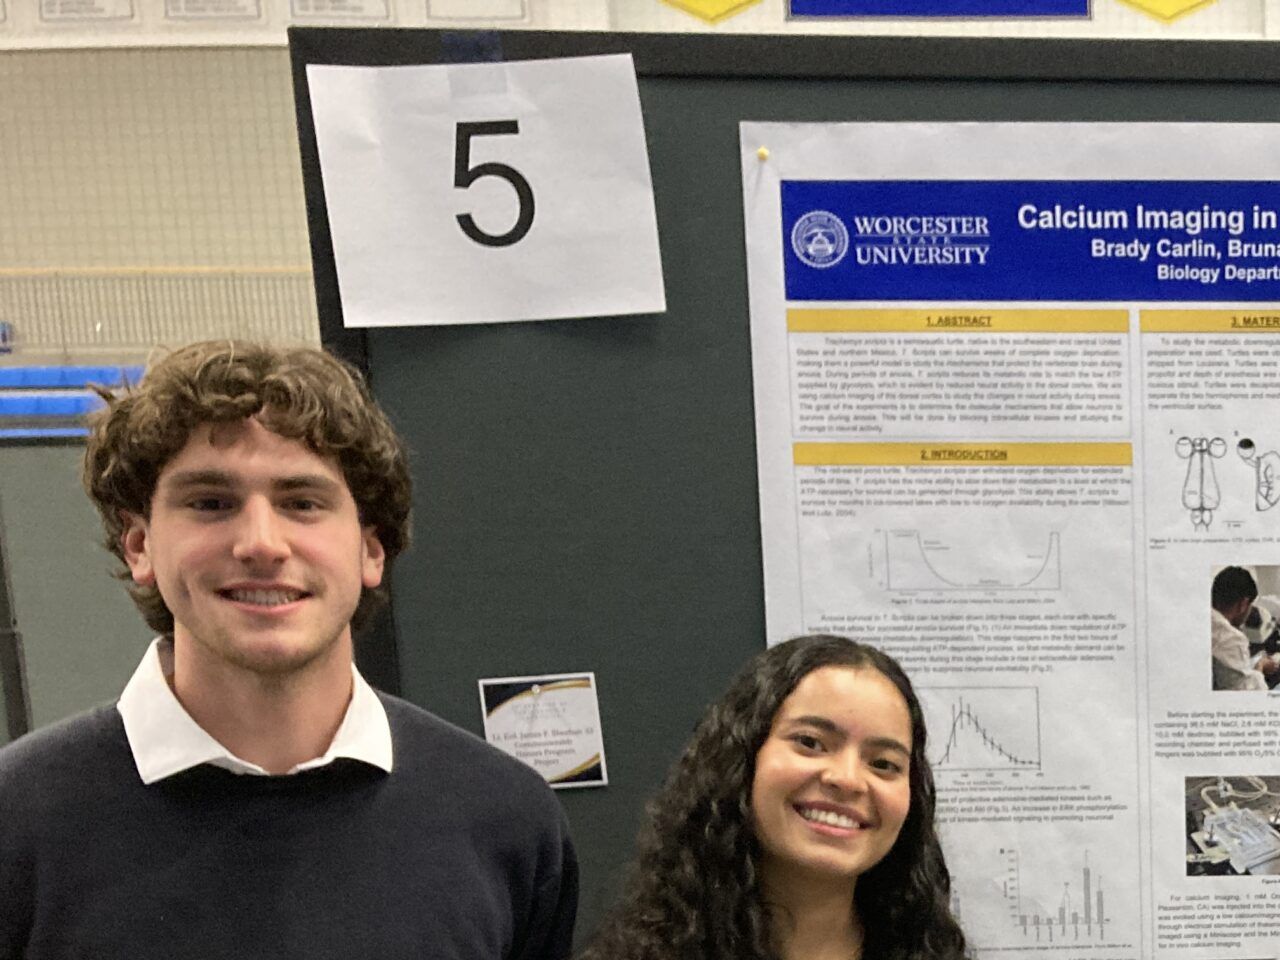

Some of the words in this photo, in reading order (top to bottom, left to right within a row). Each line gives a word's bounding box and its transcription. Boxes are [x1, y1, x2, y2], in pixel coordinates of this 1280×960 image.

[453, 119, 536, 247] 5
[854, 216, 990, 235] WORCESTER
[1017, 204, 1127, 231] Calcium
[1136, 205, 1244, 238] Imaging
[1251, 206, 1278, 233] in
[856, 247, 990, 265] UNIVERSITY
[1091, 237, 1151, 263] Brady
[1156, 237, 1221, 263] Carlin,
[1156, 264, 1220, 285] Biology
